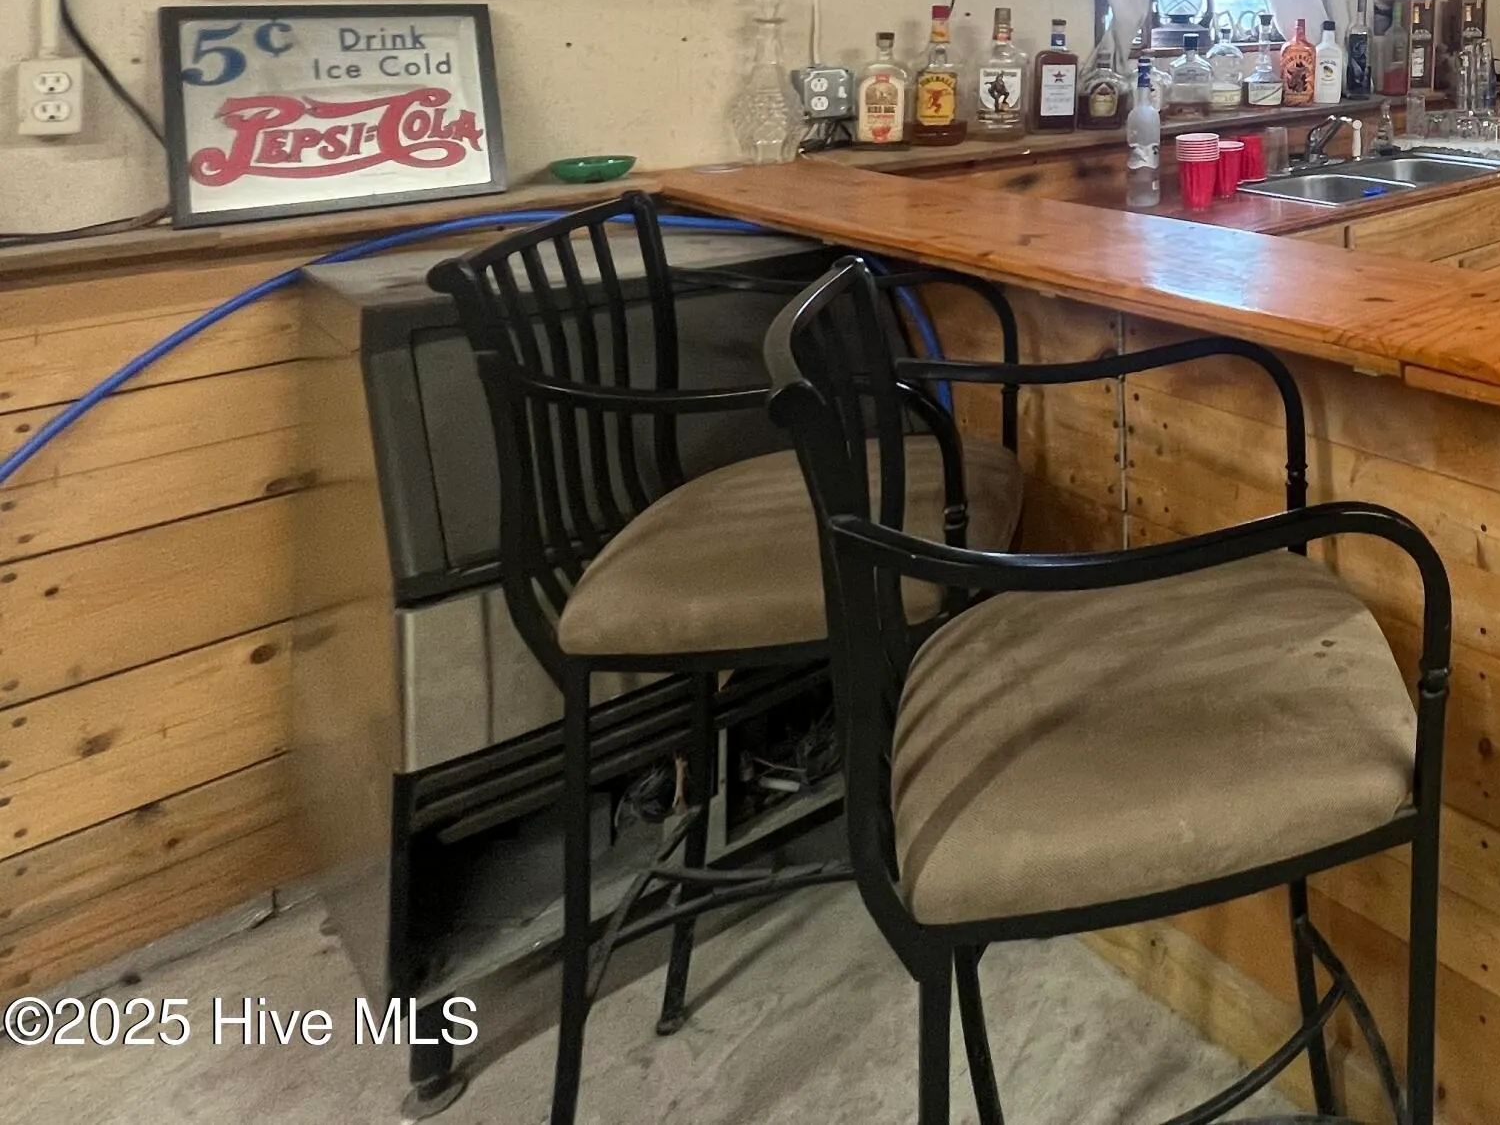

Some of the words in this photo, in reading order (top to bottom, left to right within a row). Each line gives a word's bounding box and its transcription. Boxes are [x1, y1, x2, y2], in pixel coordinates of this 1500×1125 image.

[181, 18, 294, 87] 5¢
[339, 26, 426, 51] Drink
[313, 58, 362, 80] Ice
[379, 52, 452, 77] Cold
